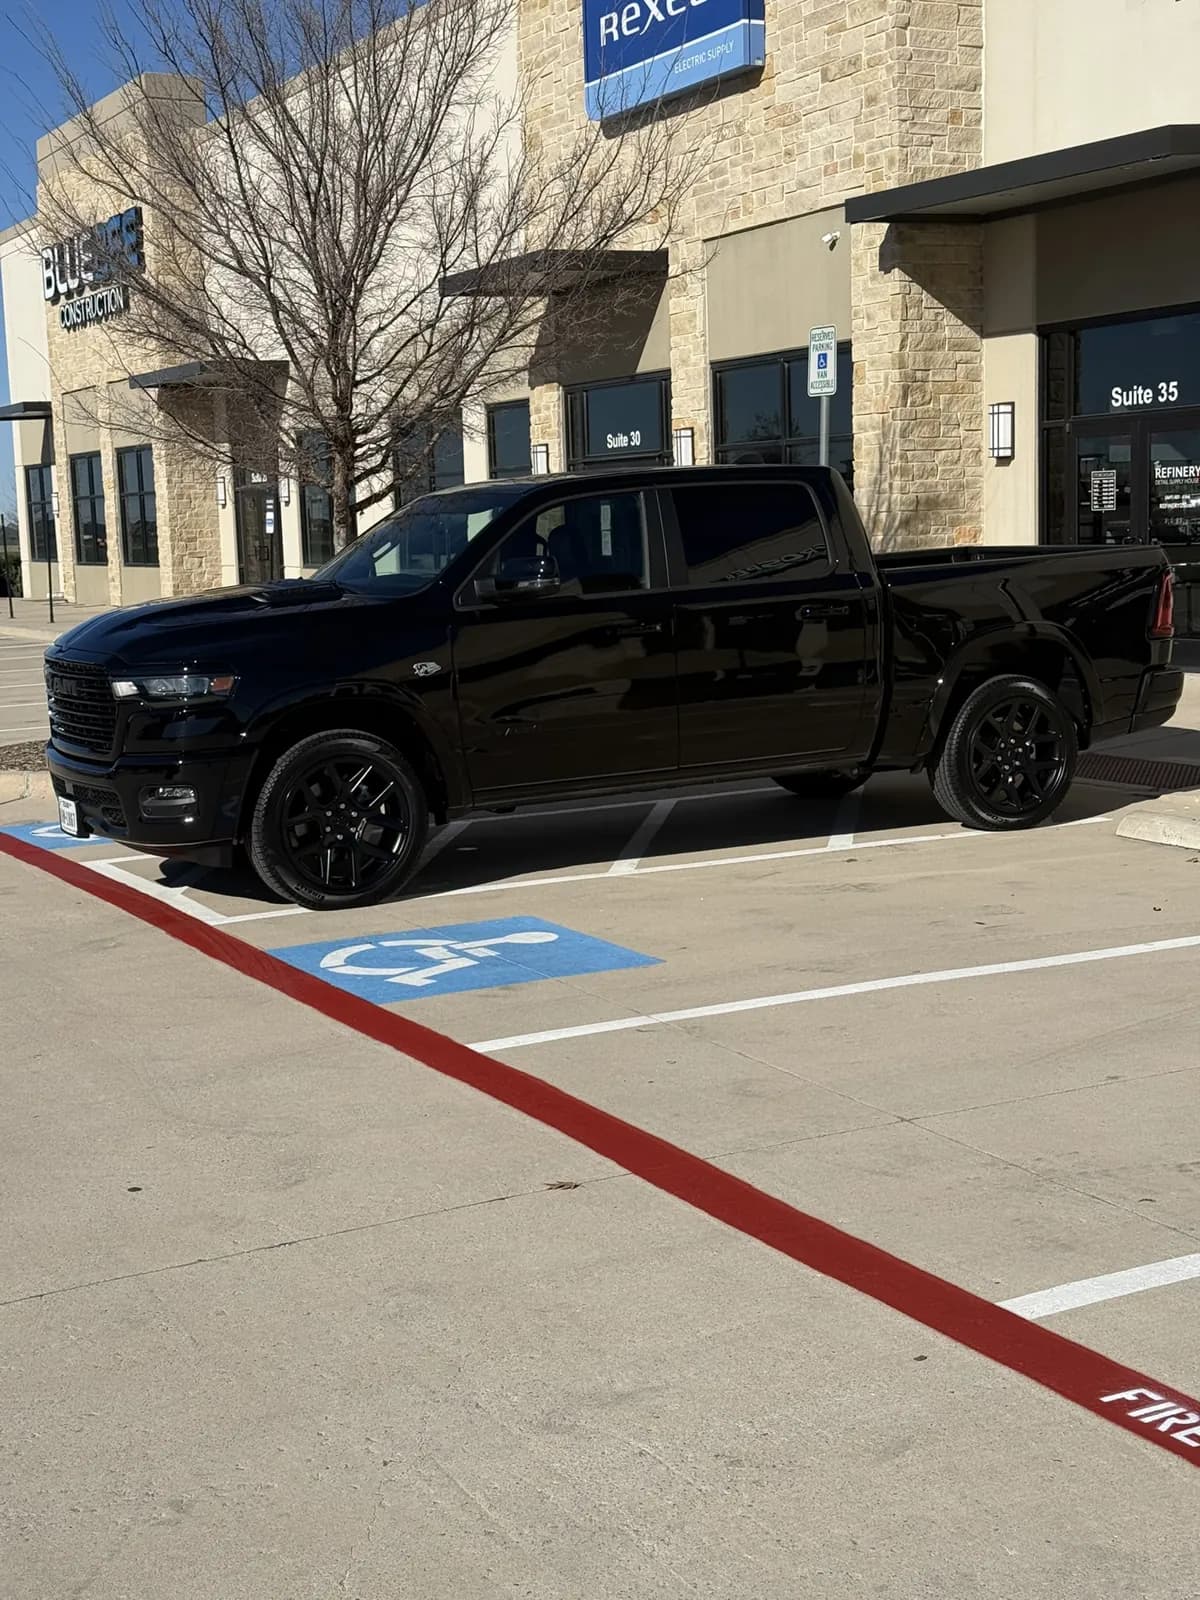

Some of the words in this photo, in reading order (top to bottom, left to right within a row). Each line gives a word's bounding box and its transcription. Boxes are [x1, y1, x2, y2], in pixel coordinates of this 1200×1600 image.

[674, 52, 706, 74] ELECTRIC
[707, 40, 734, 61] SUPPLY
[60, 287, 124, 328] CONSTRUCTION
[812, 342, 833, 352] PARKING
[817, 370, 828, 379] VAN
[1111, 385, 1153, 407] Suite
[1158, 381, 1178, 402] 35
[607, 433, 628, 449] Suite
[630, 430, 641, 446] 30
[1155, 465, 1200, 479] REFINERY
